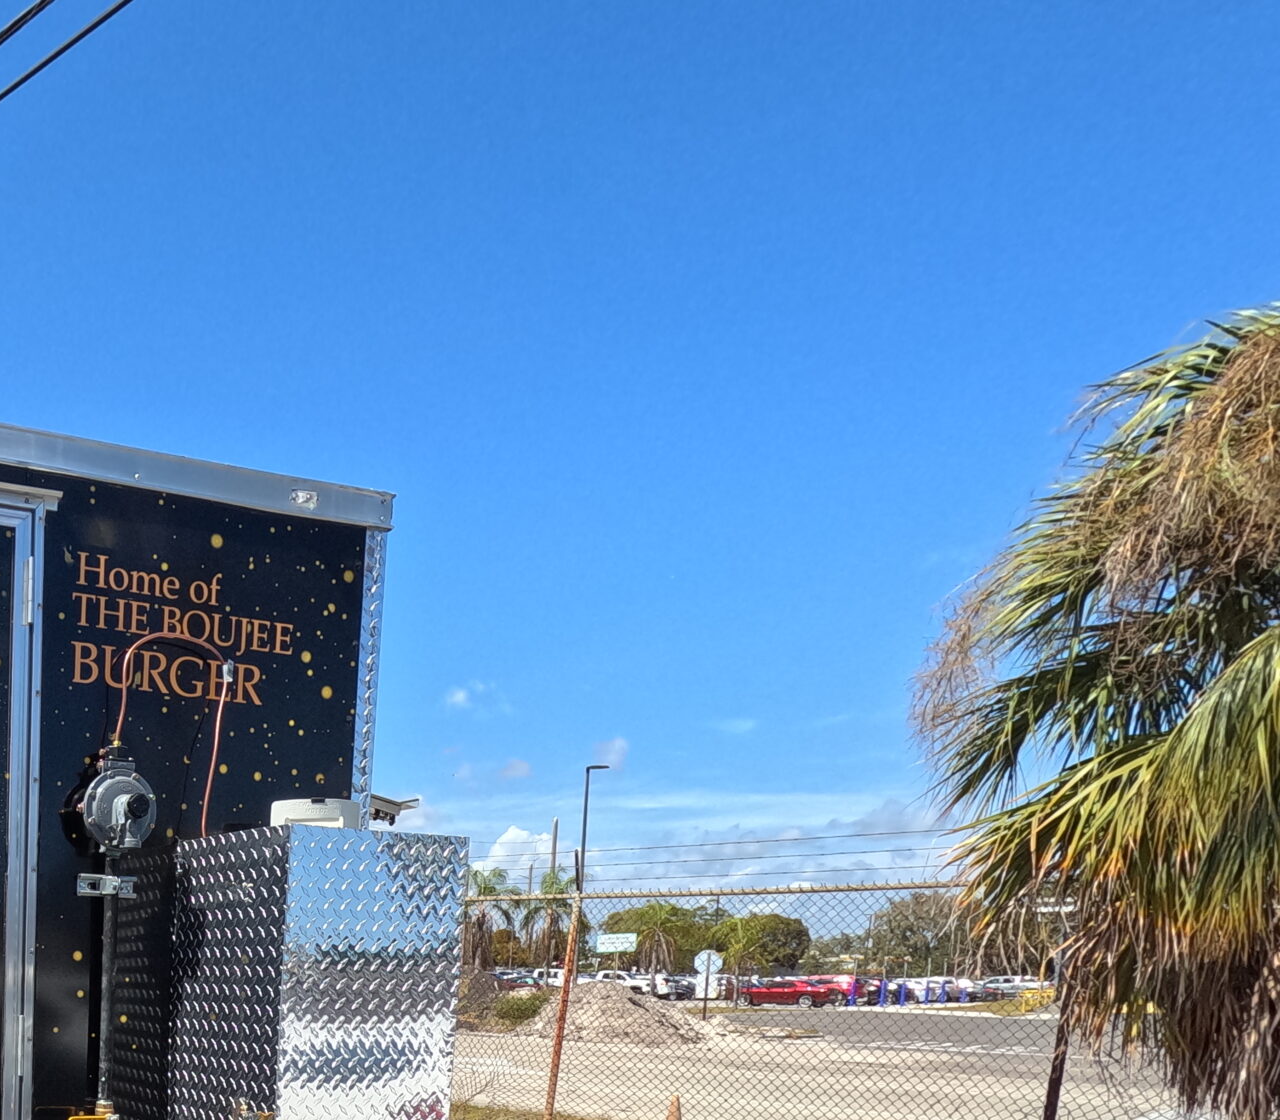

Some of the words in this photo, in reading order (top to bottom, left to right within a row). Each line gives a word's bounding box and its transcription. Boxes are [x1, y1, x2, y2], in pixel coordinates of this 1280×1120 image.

[76, 551, 180, 599] Home
[189, 573, 223, 606] of
[72, 592, 151, 635] THE
[161, 605, 294, 656] BOUJEE
[70, 641, 263, 706] BURGER
